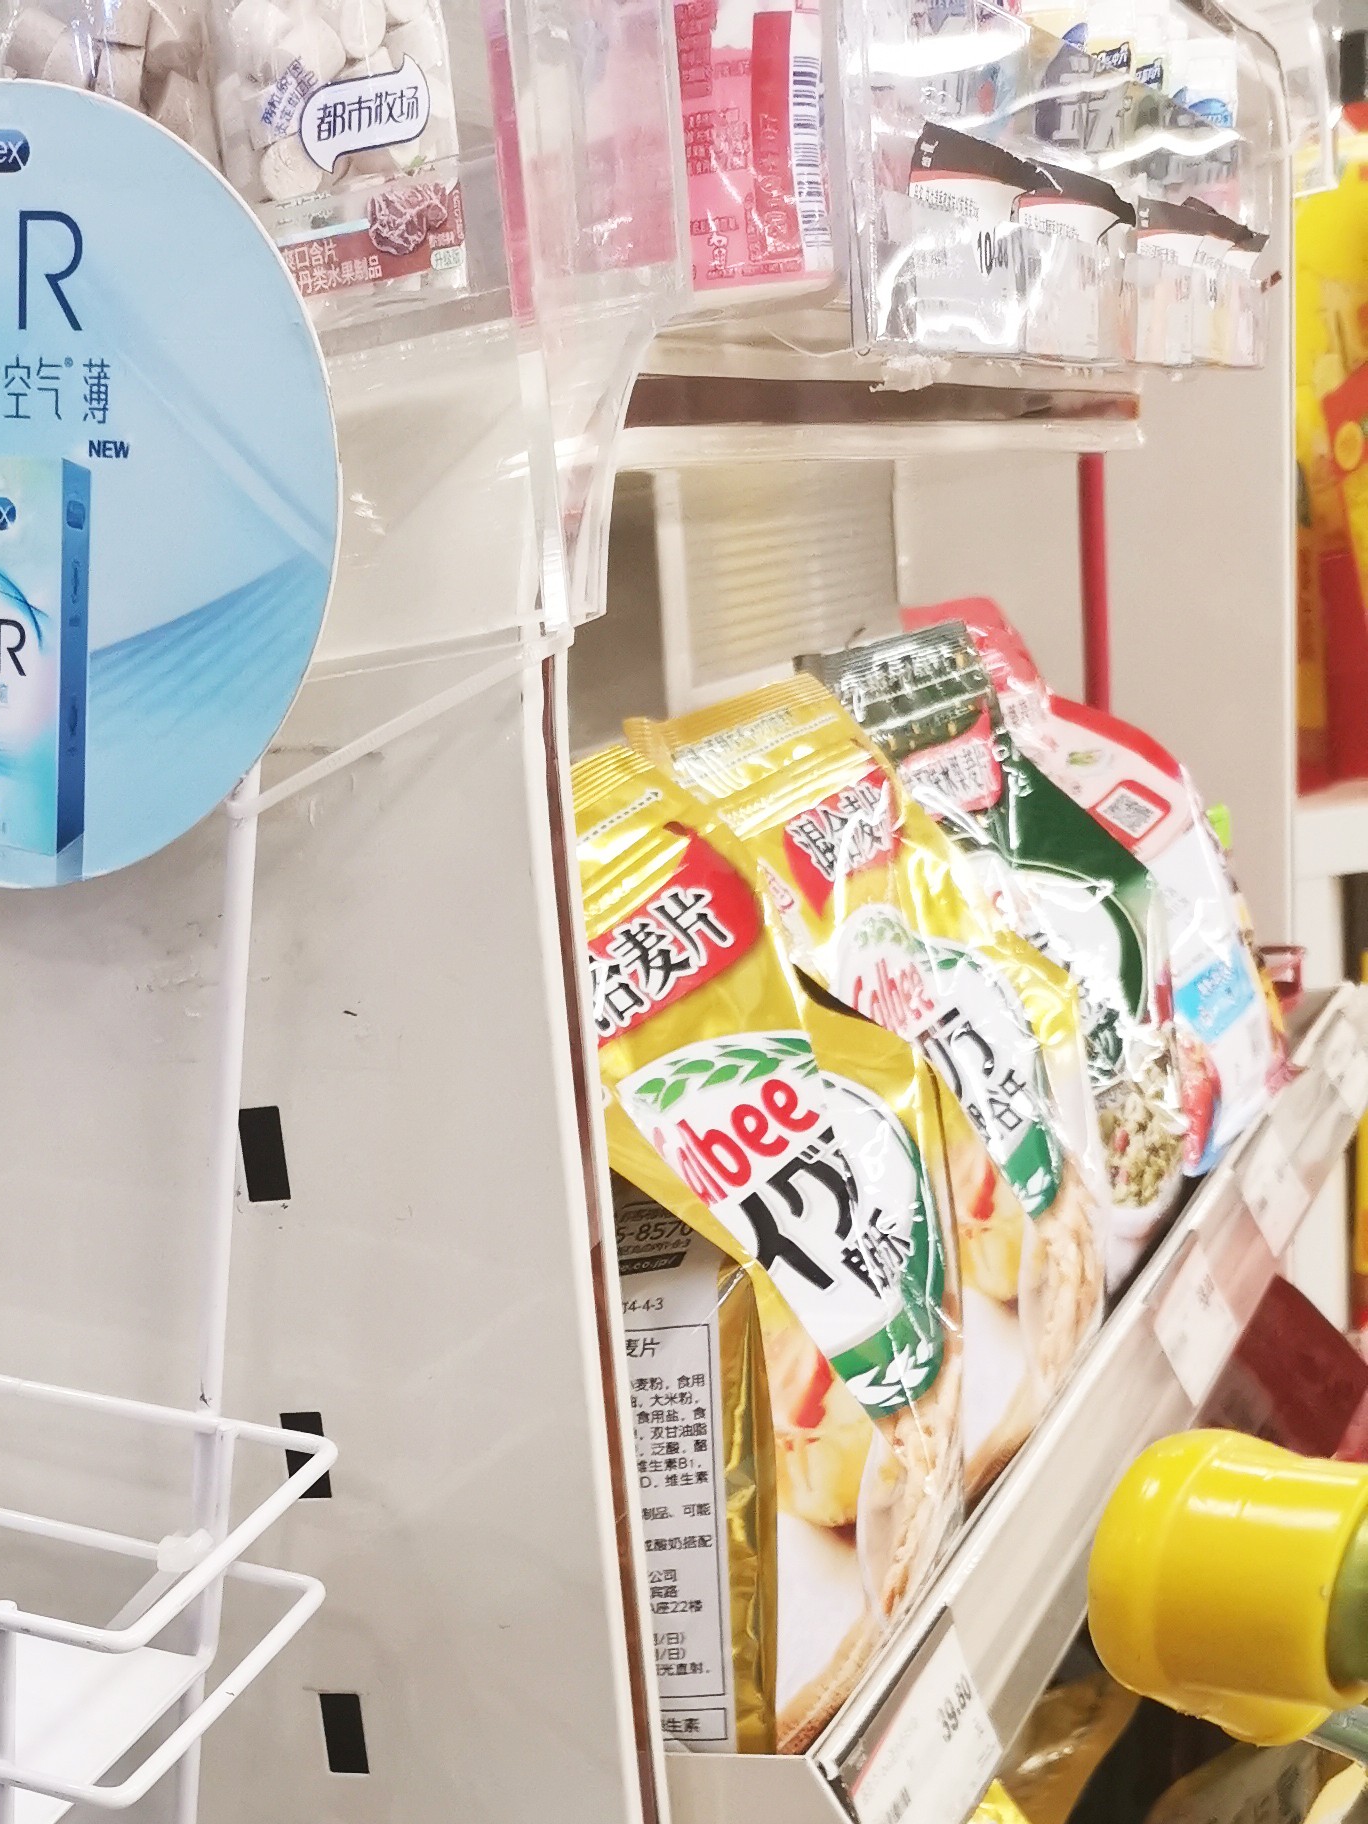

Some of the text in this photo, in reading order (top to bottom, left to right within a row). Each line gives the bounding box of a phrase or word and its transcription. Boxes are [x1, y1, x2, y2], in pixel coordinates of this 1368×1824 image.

[316, 85, 420, 142] 都市牧场
[294, 255, 384, 296] 丹类水果制品
[87, 440, 131, 460] NEW
[649, 1568, 678, 1583] 公司
